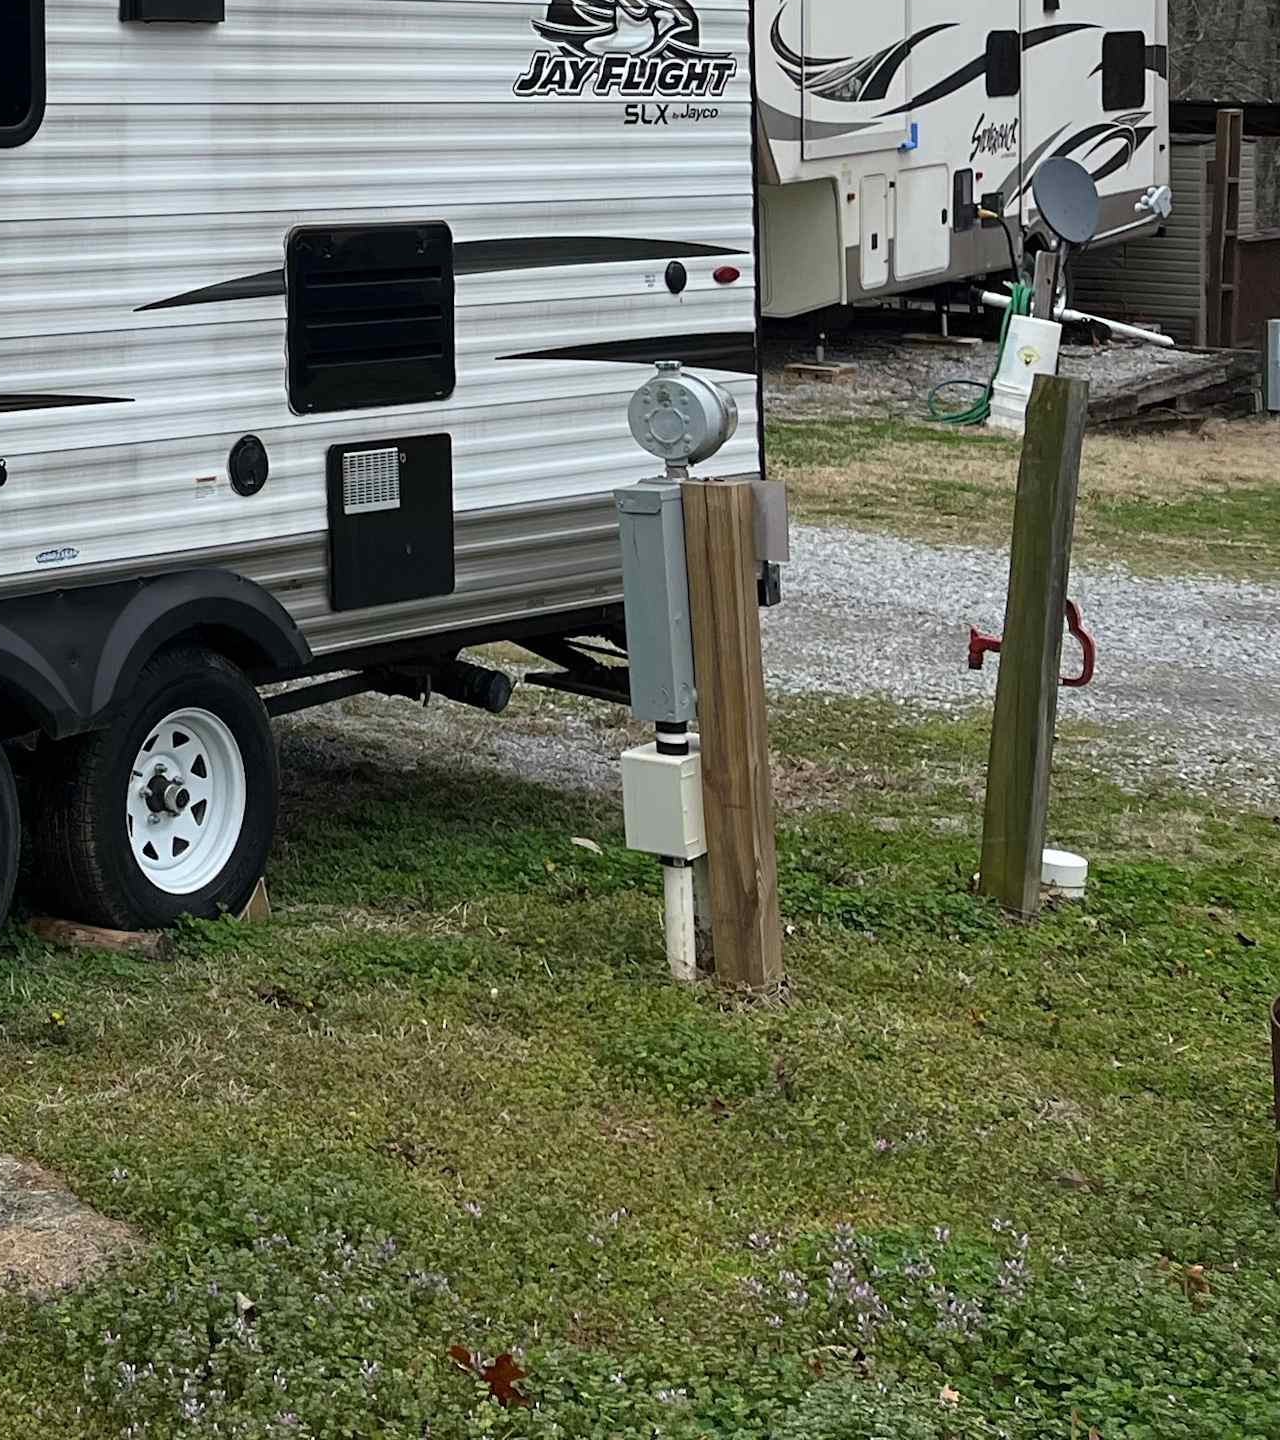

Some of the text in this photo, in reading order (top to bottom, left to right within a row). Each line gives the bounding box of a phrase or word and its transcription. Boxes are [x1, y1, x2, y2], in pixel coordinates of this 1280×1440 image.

[514, 51, 737, 96] JAY FLIGHT
[624, 104, 669, 125] SLX
[680, 103, 719, 122] Jayco
